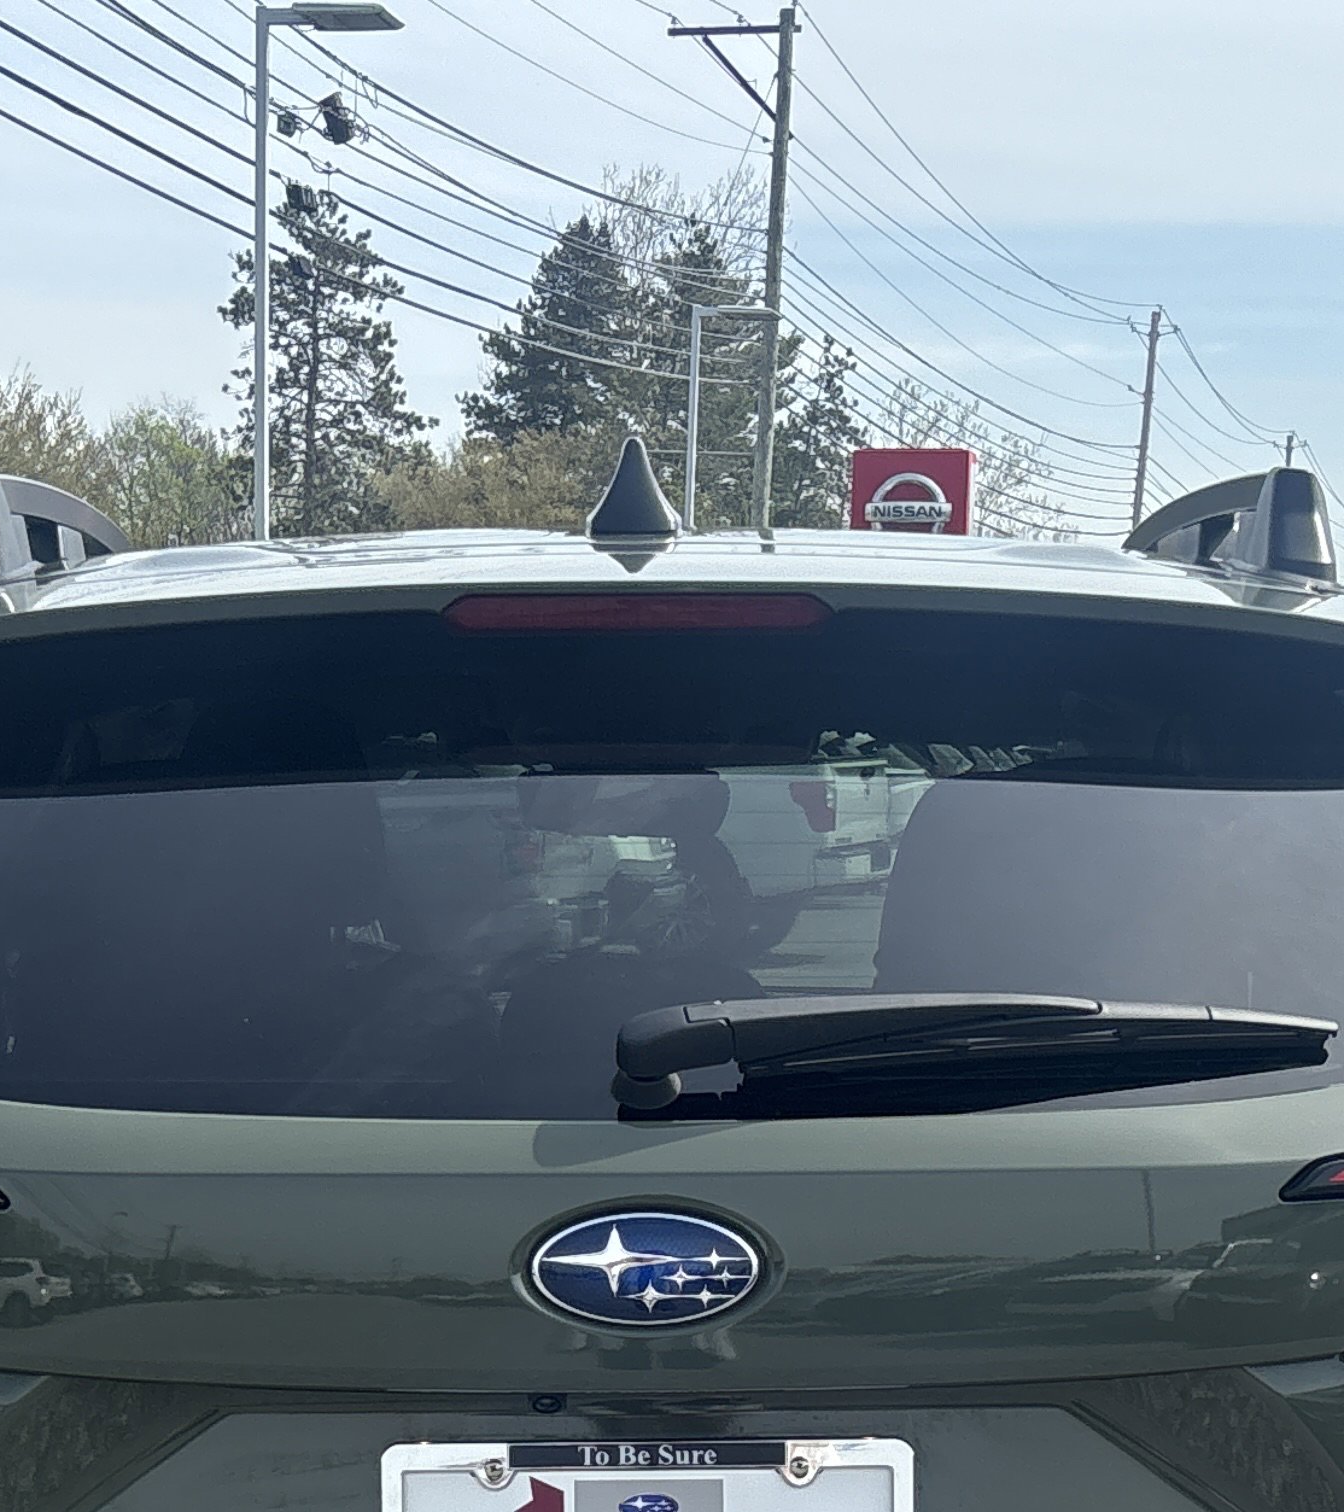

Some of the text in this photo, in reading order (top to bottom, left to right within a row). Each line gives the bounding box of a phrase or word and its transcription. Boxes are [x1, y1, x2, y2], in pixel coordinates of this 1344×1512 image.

[873, 505, 942, 518] NISSAN
[577, 1445, 718, 1466] To Be Sure
